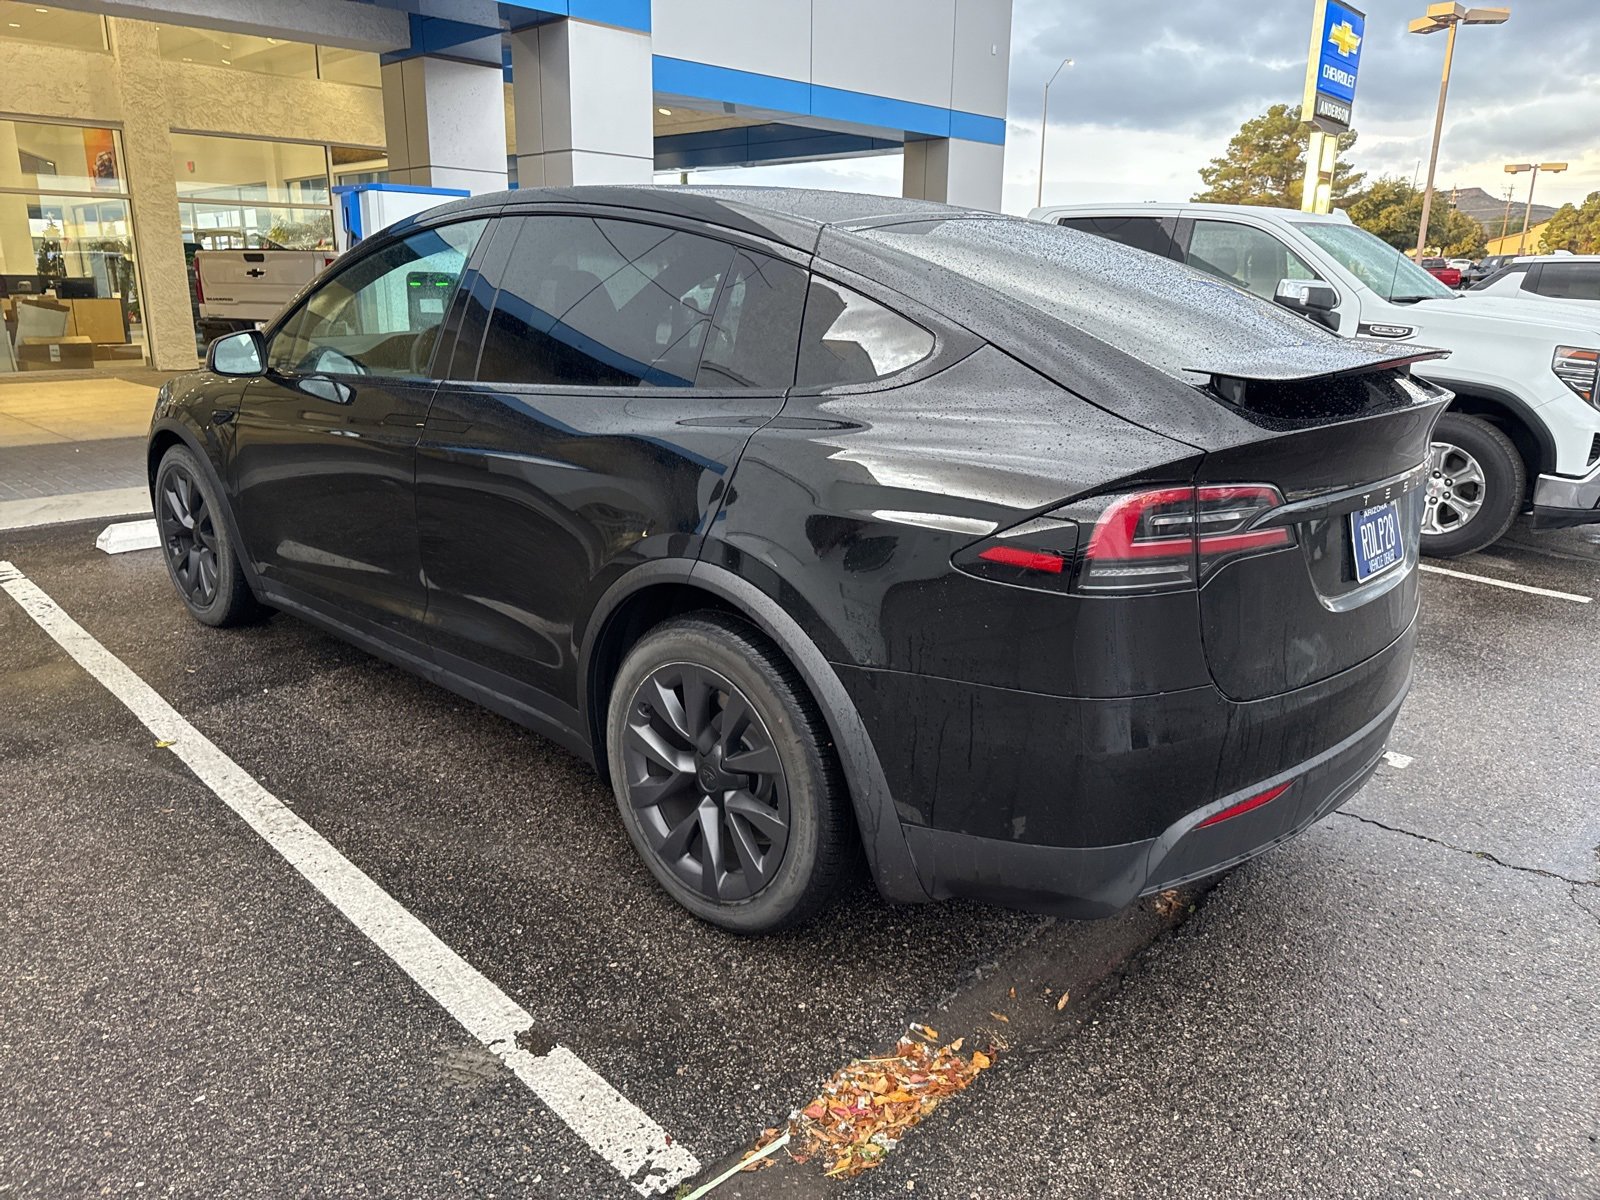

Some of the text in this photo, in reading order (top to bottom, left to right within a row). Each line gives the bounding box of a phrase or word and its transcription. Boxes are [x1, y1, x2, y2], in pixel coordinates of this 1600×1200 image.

[1322, 64, 1356, 88] CHEVROLET
[1319, 100, 1350, 122] ANDERSON
[1363, 502, 1388, 518] ARIZONA
[1360, 513, 1396, 561] RDLP28
